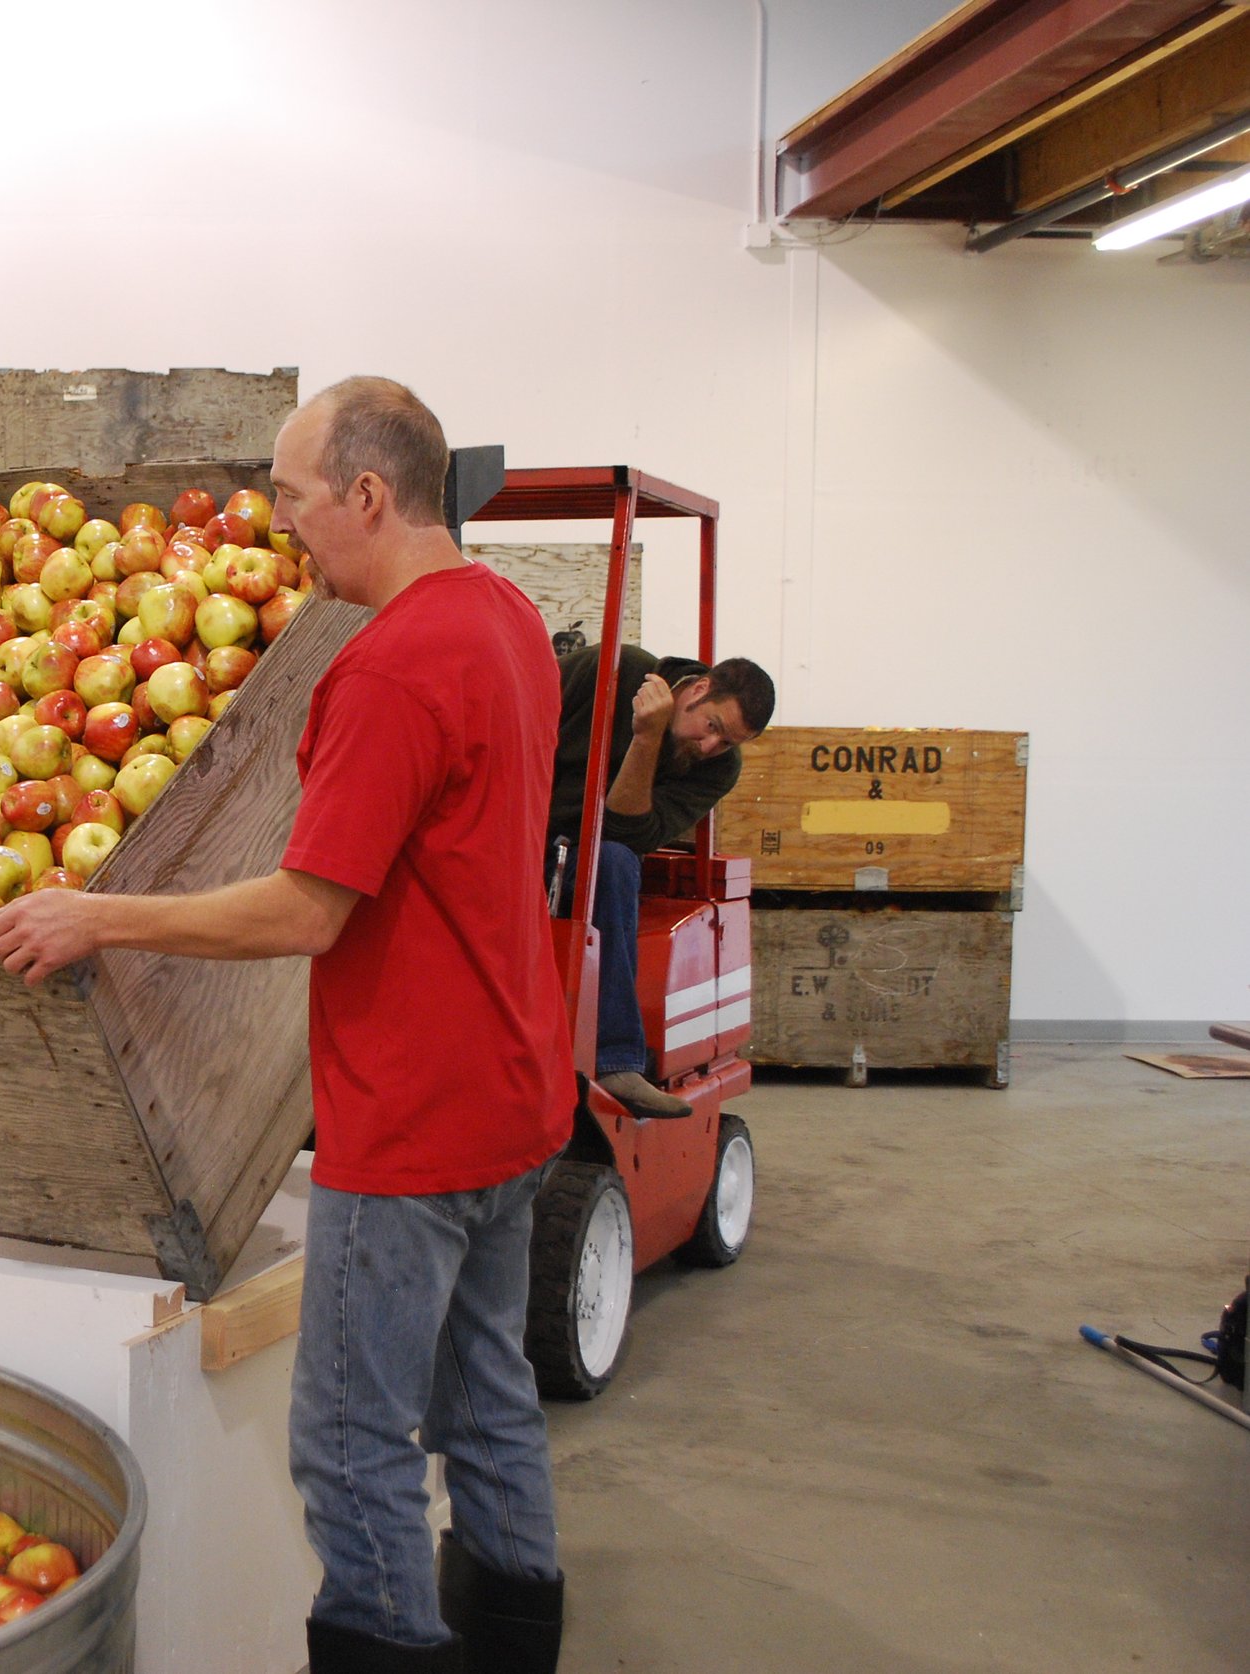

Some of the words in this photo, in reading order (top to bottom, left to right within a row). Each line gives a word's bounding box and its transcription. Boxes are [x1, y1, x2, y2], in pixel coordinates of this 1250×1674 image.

[811, 744, 942, 774] CONRAD
[868, 779, 883, 800] &
[865, 841, 884, 855] 09
[821, 1002, 837, 1022] &
